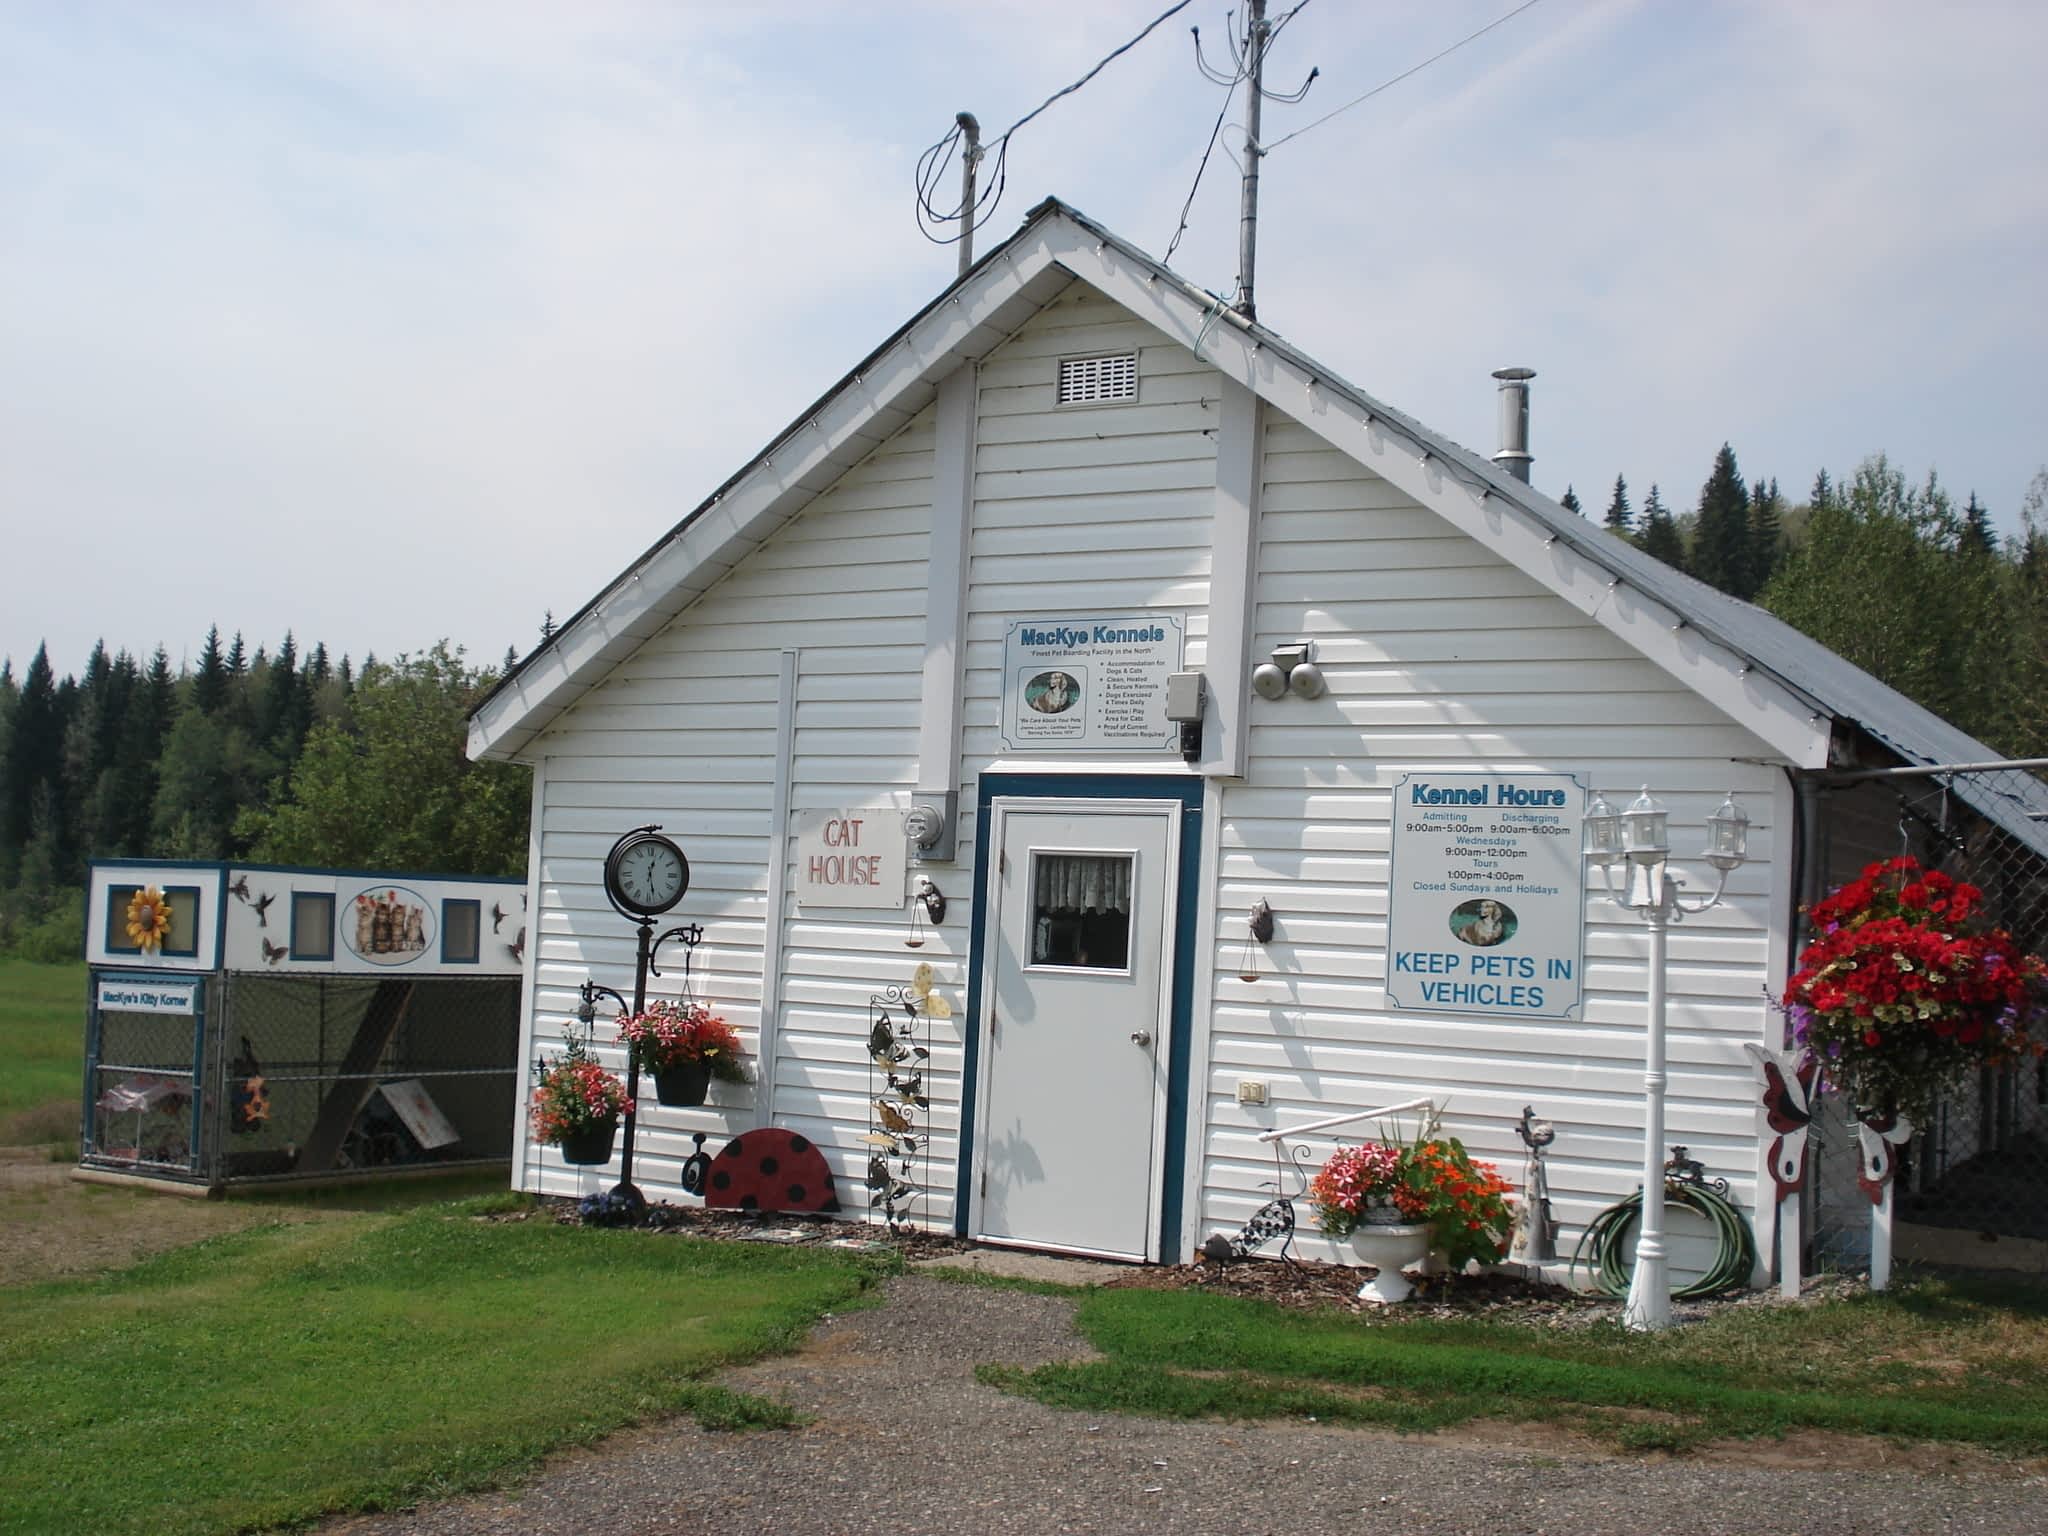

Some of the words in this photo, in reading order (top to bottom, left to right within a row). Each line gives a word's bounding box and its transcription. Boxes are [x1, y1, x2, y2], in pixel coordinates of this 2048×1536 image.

[1021, 627, 1089, 648] MacKye
[1093, 625, 1164, 644] Kennels
[1063, 649, 1091, 657] Boarding
[1092, 648, 1114, 656] Facility
[1412, 783, 1488, 805] Kennel
[1497, 784, 1566, 805] Hours
[1423, 812, 1468, 822] Admitting
[1502, 813, 1559, 824] Discharging
[824, 819, 864, 847] CAT
[1406, 823, 1483, 834] 9:00am-5:00pm
[1456, 836, 1517, 847] Wednesdays
[1445, 847, 1528, 858] 9:00am-12:00pm
[808, 855, 882, 886] HOUSE
[1473, 859, 1499, 868] Tours
[1447, 871, 1524, 881] 1:00pm-4:00pm
[1413, 881, 1446, 891] Closed
[1450, 882, 1490, 894] Sundays
[1494, 883, 1513, 893] and
[1516, 884, 1559, 896] Holidays
[1395, 952, 1460, 974] KEEP
[1471, 955, 1535, 979] PETS
[1547, 958, 1572, 980] IN
[103, 991, 138, 1006] MacKye's
[140, 992, 159, 1007] Kitty
[160, 993, 188, 1006] Korner
[1420, 981, 1544, 1008] VEHICLES
